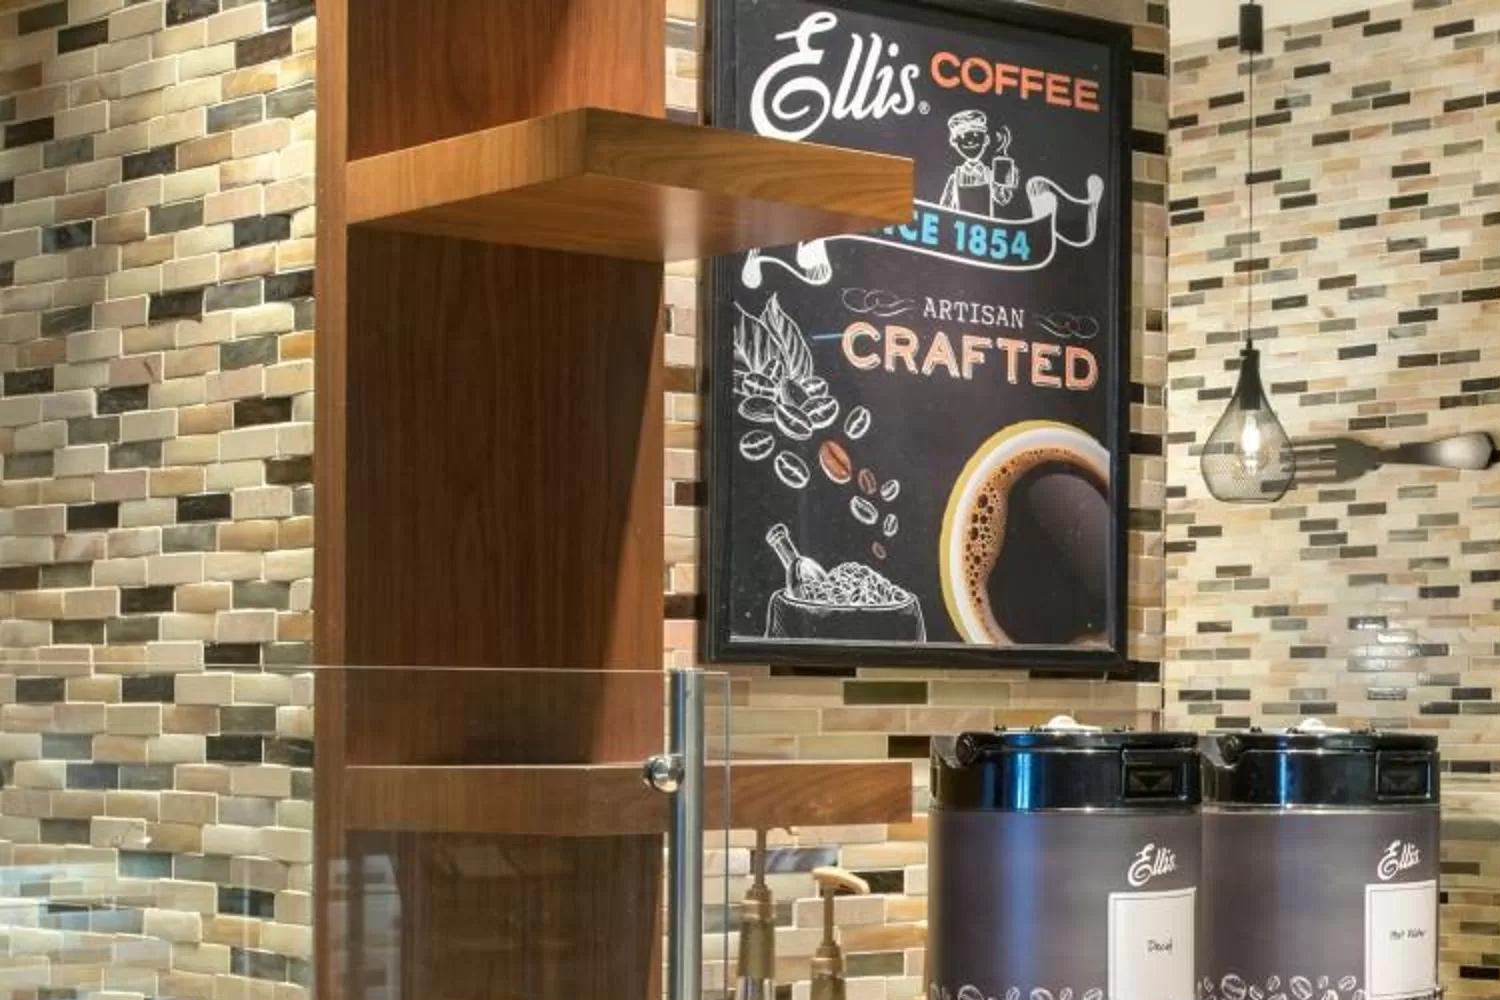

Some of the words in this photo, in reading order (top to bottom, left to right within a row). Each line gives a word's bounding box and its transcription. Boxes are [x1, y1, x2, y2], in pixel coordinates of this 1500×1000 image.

[930, 51, 1100, 112] COFFEE
[953, 219, 1032, 261] 1854
[923, 297, 1025, 330] ARTISAN
[841, 321, 1099, 391] CRAFTED
[1127, 843, 1177, 887] Ellis
[1377, 840, 1420, 880] Ellis
